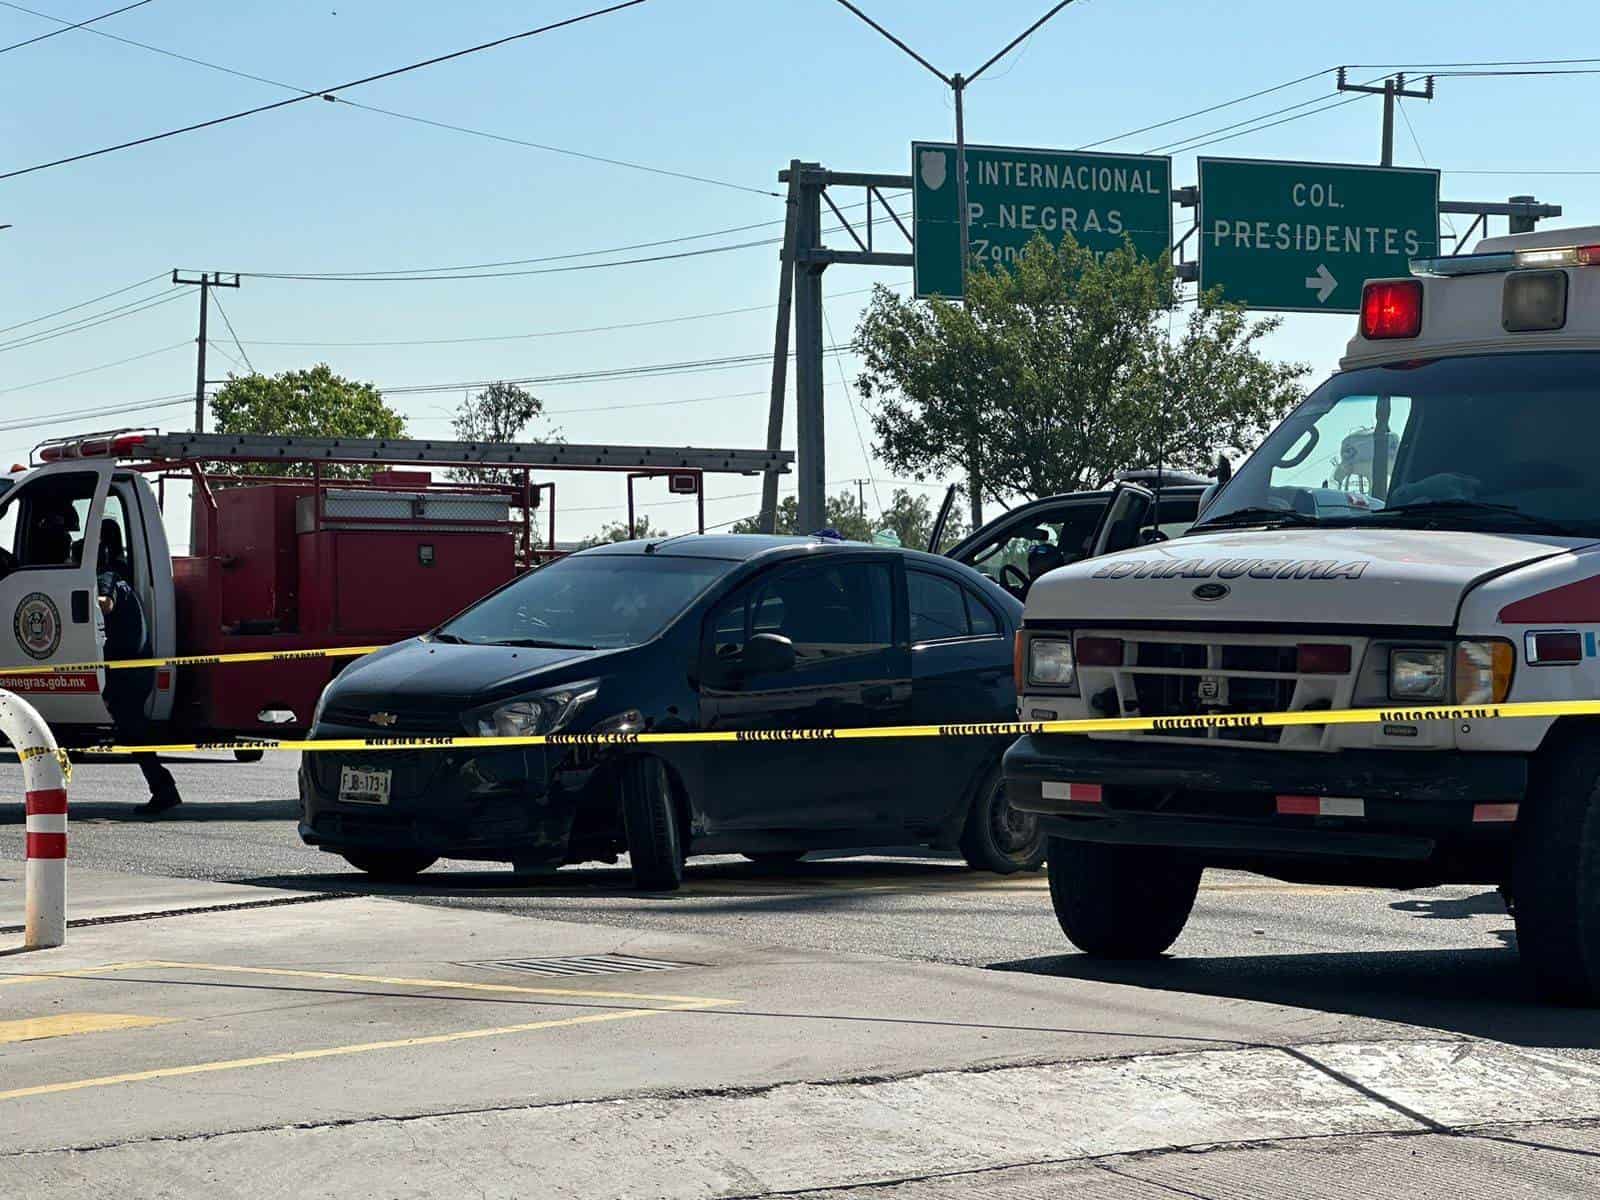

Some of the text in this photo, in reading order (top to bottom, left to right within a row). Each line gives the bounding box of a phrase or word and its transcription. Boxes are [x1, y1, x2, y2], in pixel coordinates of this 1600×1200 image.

[978, 160, 1160, 194] INTERNACIONAL
[1293, 183, 1345, 208] COL.
[1000, 204, 1123, 234] NEGRAS
[1214, 219, 1420, 255] PRESIDENTES
